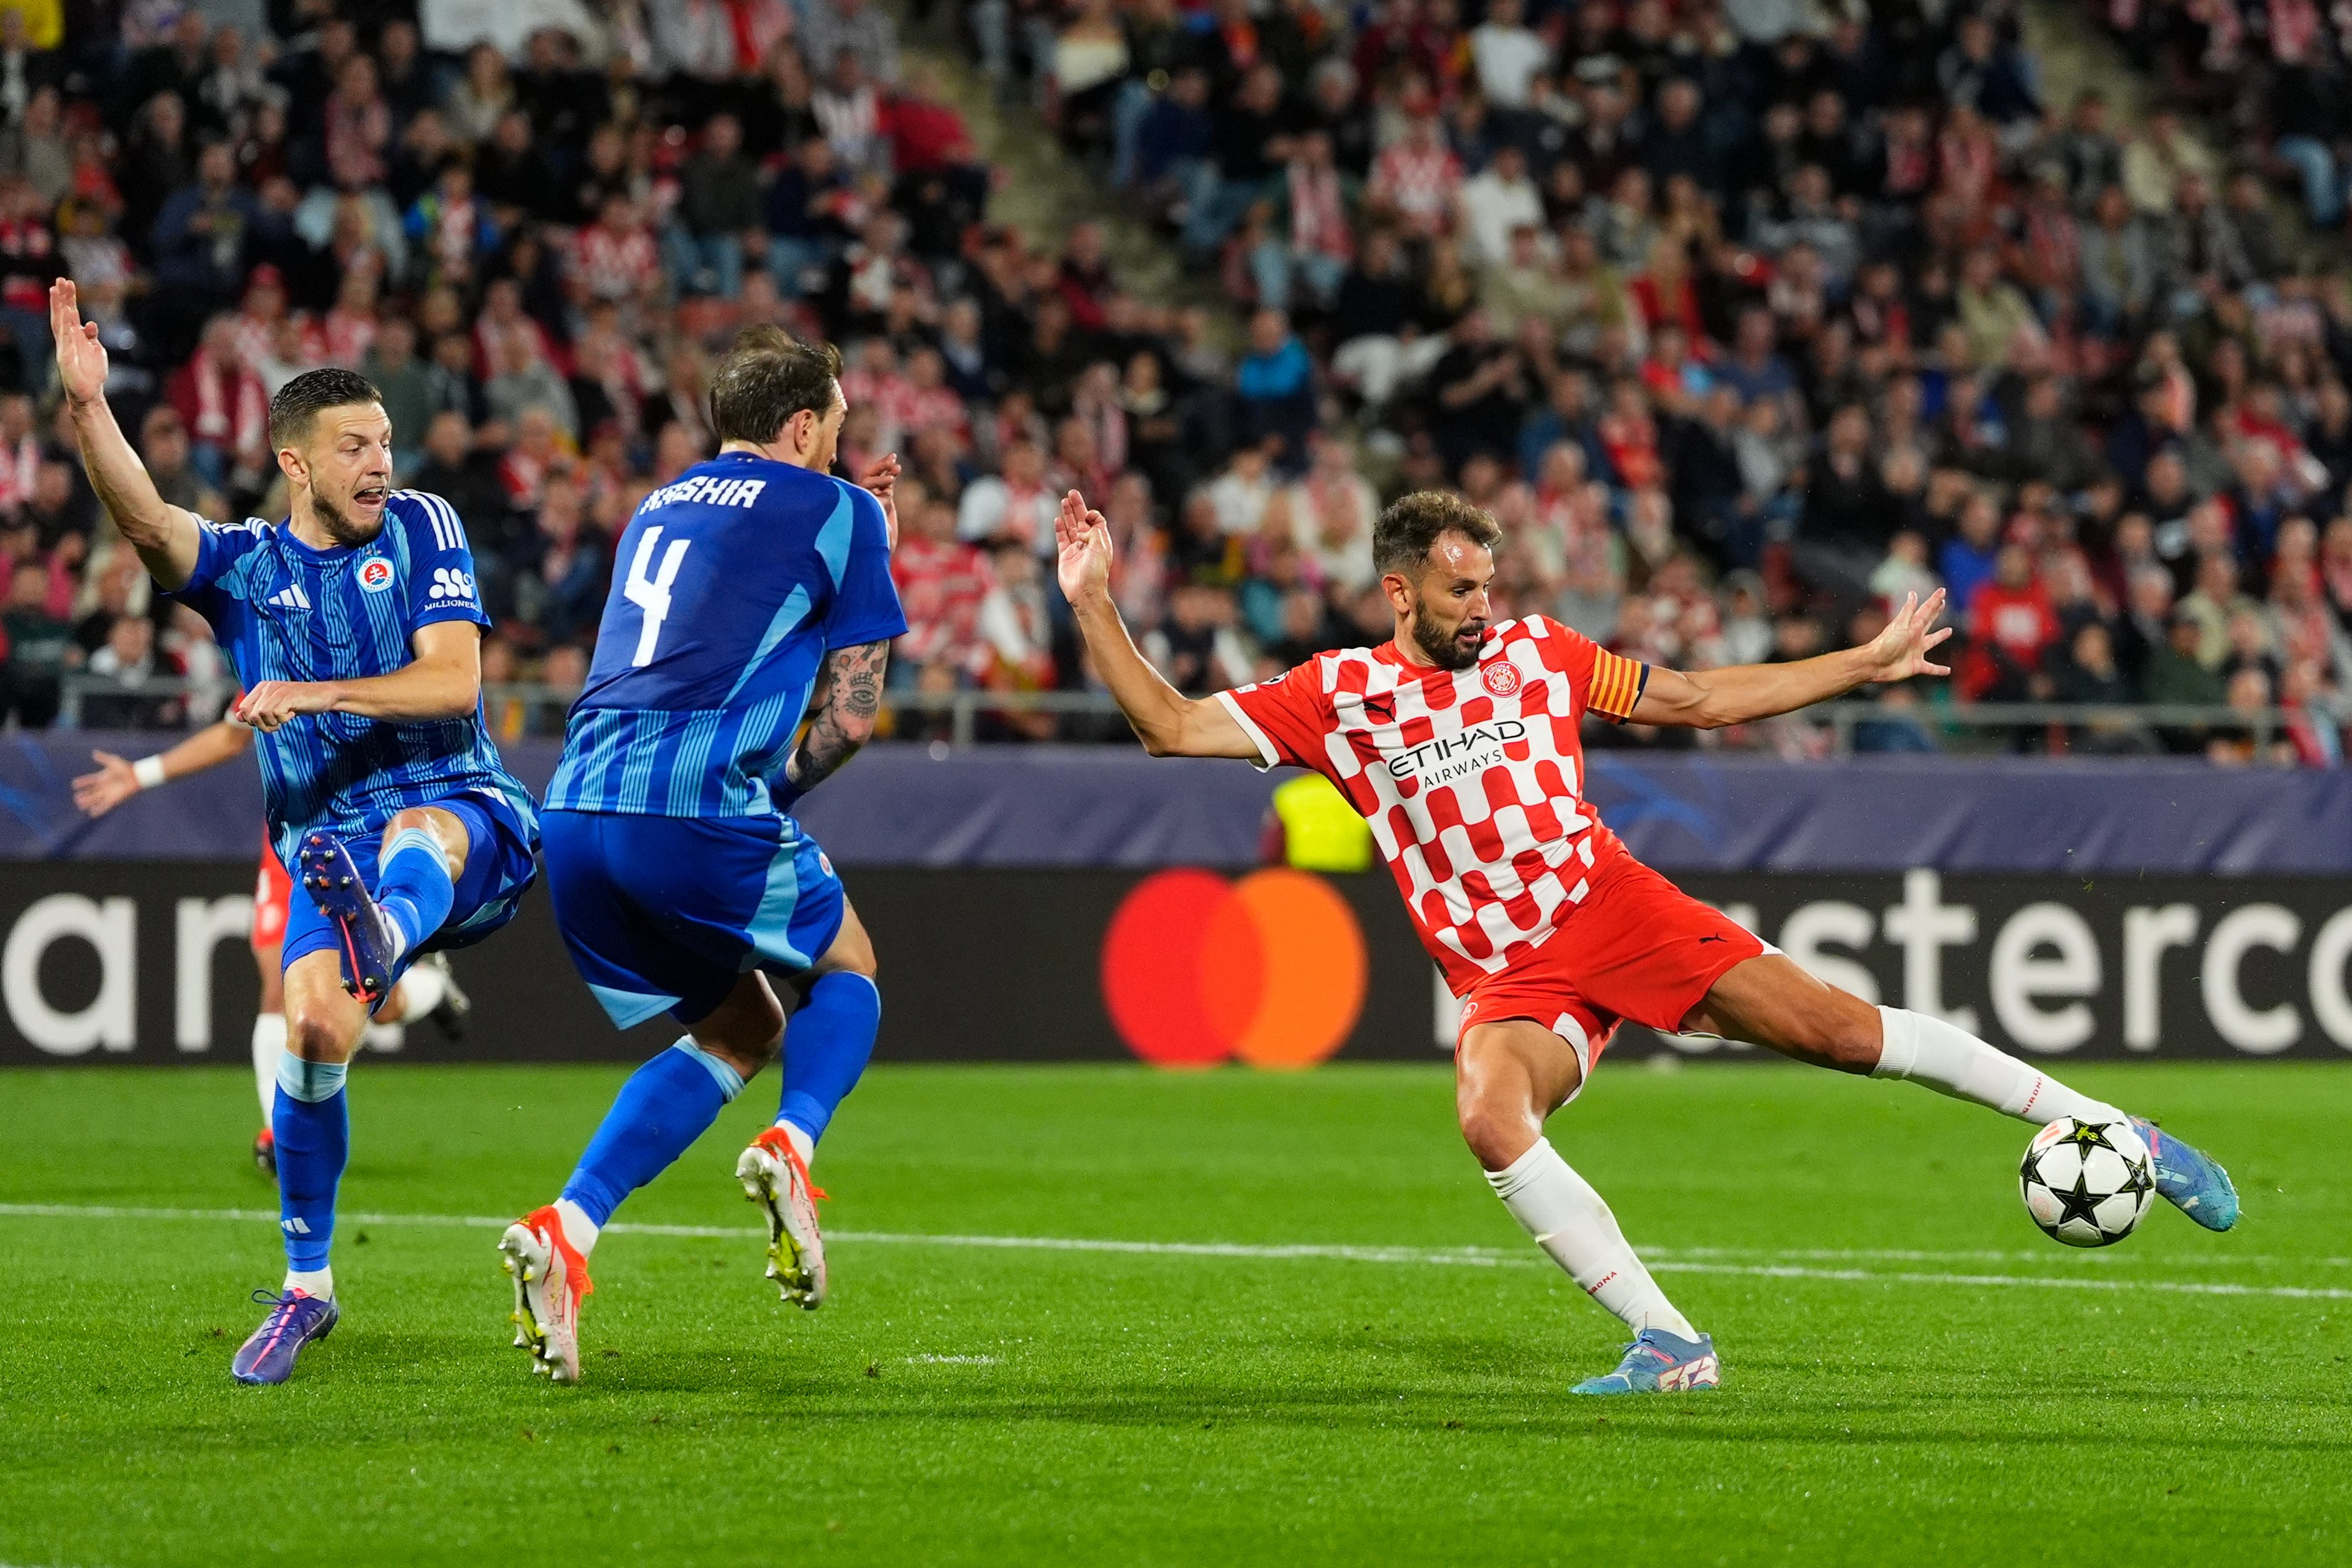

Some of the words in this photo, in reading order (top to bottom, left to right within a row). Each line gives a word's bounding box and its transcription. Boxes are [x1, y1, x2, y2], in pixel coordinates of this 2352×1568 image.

[624, 525, 691, 667] 4
[1486, 663, 1510, 676] GIRONA
[1389, 720, 1525, 777] ETIHAD
[1425, 750, 1502, 789] AIRWAYS
